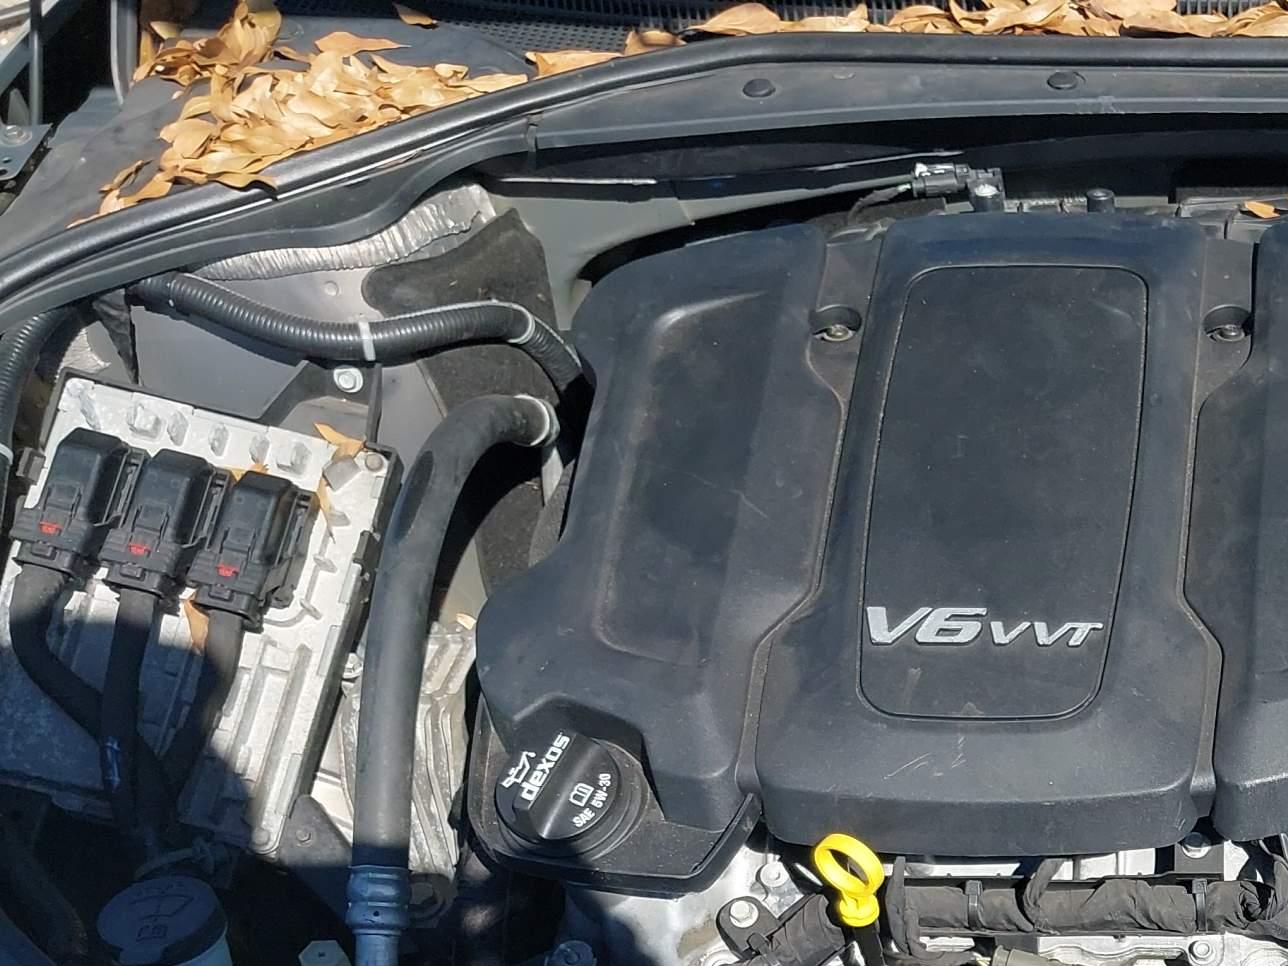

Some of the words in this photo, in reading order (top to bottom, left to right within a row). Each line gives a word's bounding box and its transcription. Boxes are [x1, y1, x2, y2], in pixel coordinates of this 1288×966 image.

[866, 606, 988, 645] V6
[990, 620, 1104, 647] VVT
[521, 733, 571, 802] dexos
[572, 807, 596, 828] SAE
[591, 773, 612, 808] 5W-30
